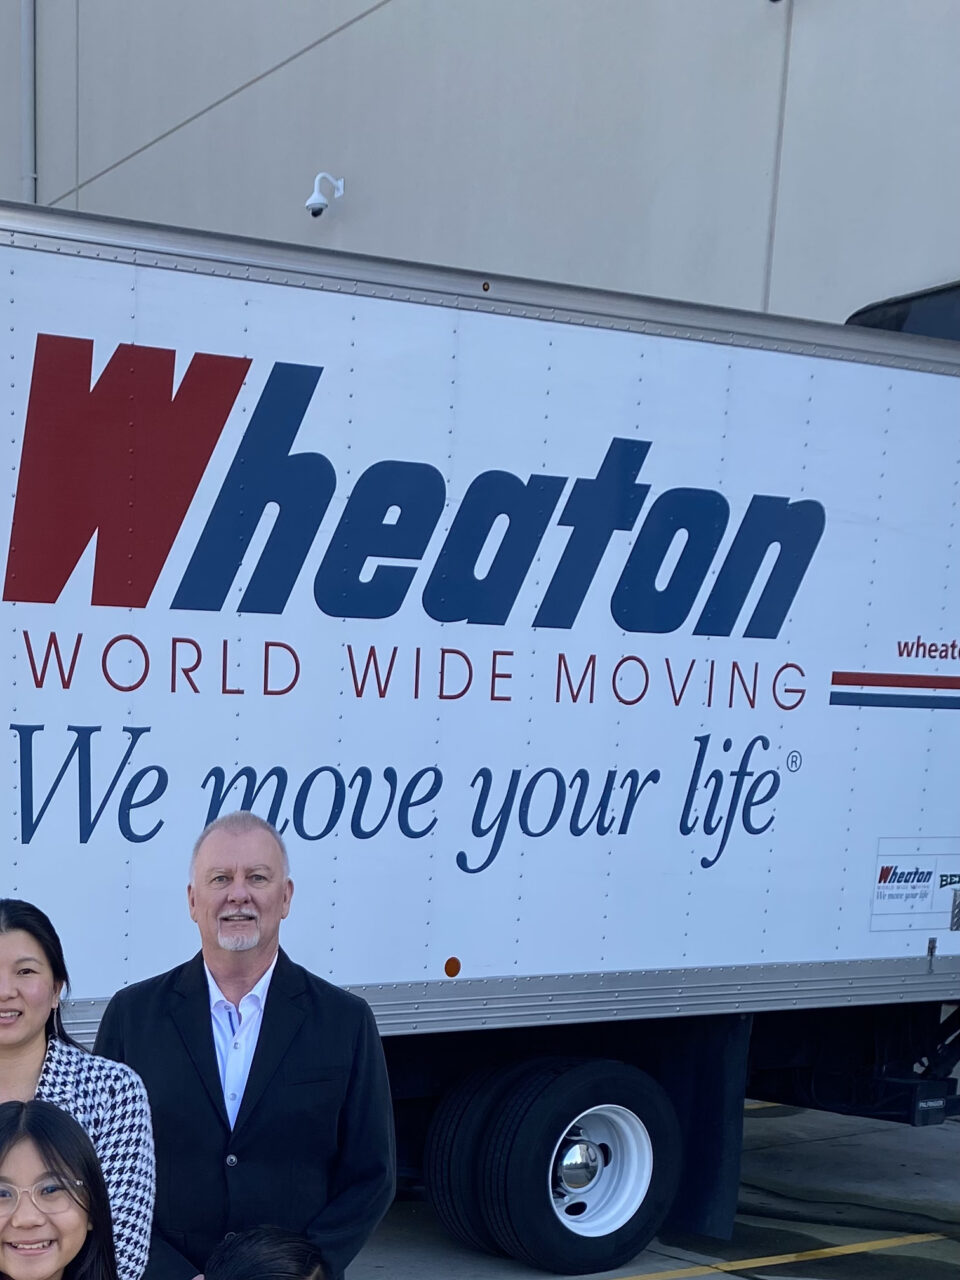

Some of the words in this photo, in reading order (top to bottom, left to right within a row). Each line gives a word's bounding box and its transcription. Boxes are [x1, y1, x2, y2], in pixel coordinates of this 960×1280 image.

[3, 333, 826, 639] Wheaton
[22, 630, 301, 696] WORLD
[347, 644, 515, 702] WIDE
[555, 652, 808, 711] MOVING
[8, 722, 169, 844] We
[200, 763, 444, 842] move
[455, 765, 661, 875] your
[878, 865, 933, 884] Wheaton
